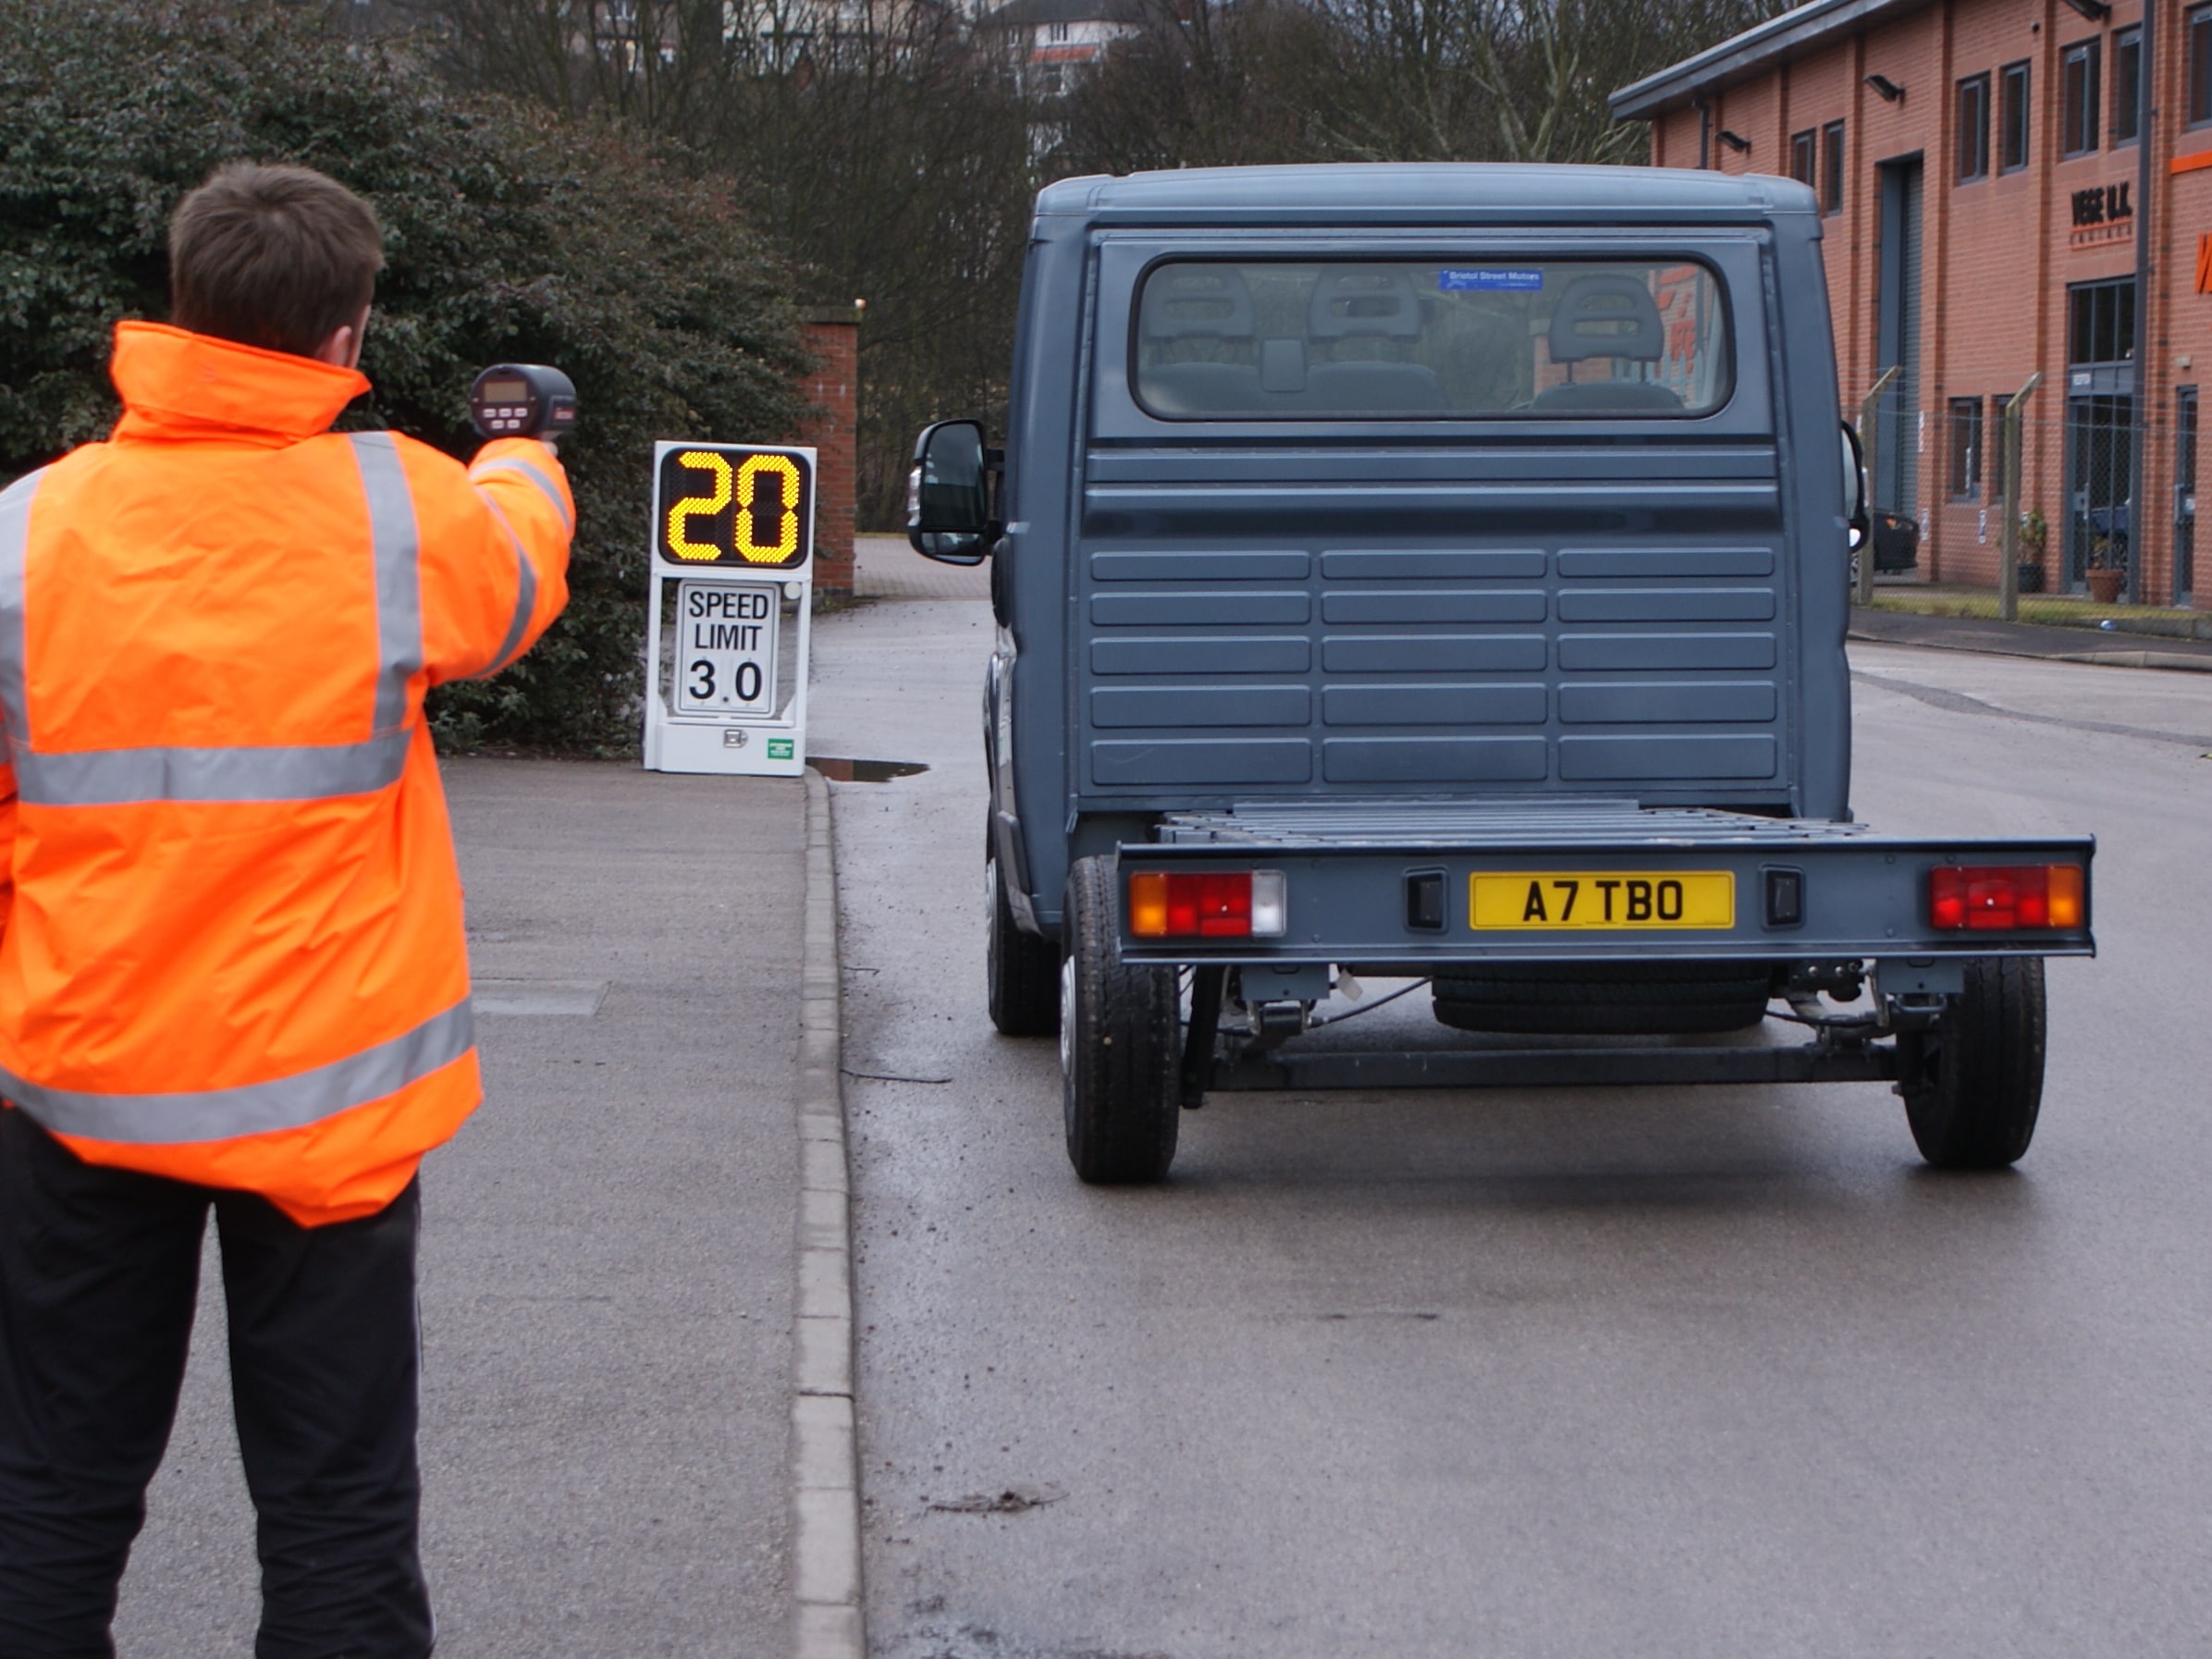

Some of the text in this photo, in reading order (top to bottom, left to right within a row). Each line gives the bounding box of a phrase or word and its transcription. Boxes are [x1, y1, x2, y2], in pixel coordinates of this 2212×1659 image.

[1449, 271, 1540, 279] Bristol Street Motors
[668, 451, 800, 563] 20
[689, 591, 768, 620] SPEED
[694, 623, 763, 651] LIMIT
[1522, 880, 1684, 922] A7 TBO
